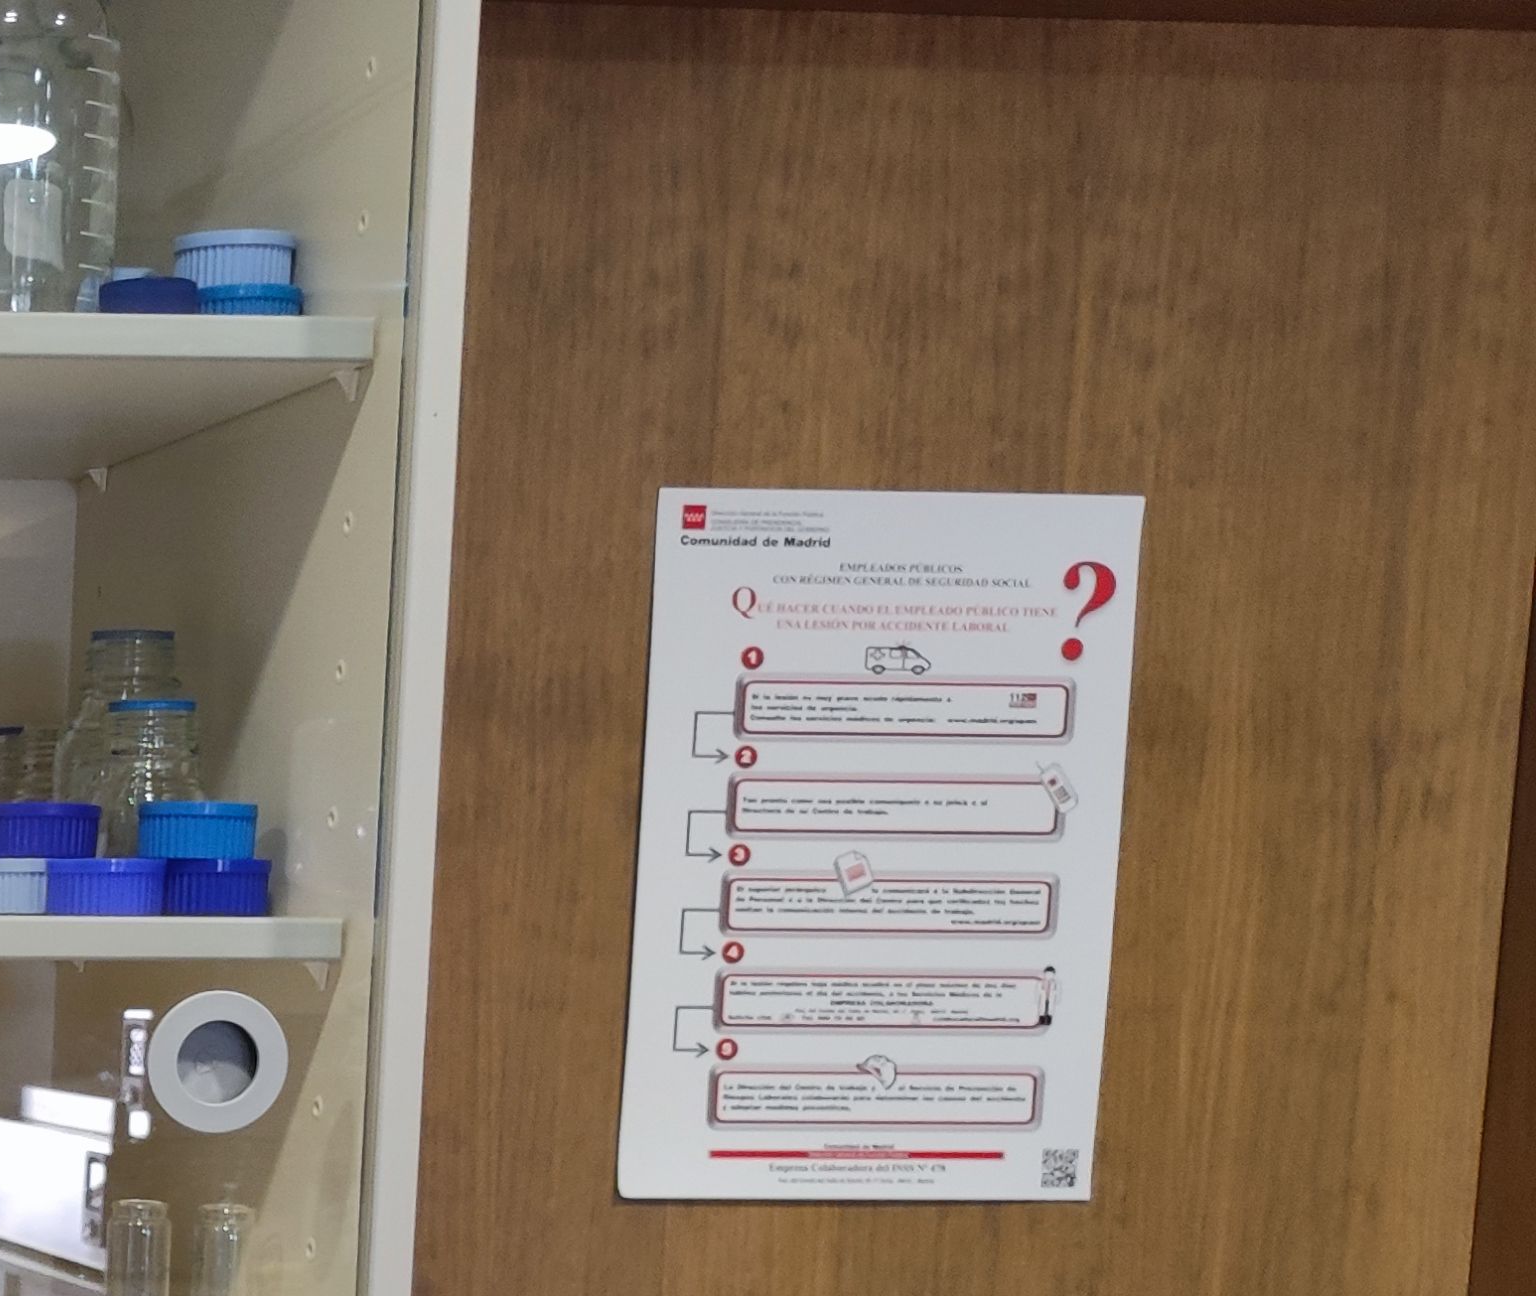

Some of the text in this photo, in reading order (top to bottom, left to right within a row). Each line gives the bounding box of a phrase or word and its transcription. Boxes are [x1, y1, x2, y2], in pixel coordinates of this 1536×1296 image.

[680, 535, 831, 549] Comunidad de Madrid
[839, 562, 906, 572] EMPLEADOS
[773, 575, 797, 585] CON
[853, 576, 904, 586] GENERAL
[908, 577, 922, 586] DE
[925, 577, 988, 587] SEGURIDAD
[992, 578, 1030, 588] SOCIAL
[777, 602, 819, 614] HACER
[822, 603, 873, 614] CUANDO
[895, 604, 962, 616] EMPLEADO
[1023, 606, 1057, 617] TIENE
[880, 621, 948, 632] ACCIDENTE
[952, 622, 1008, 633] LABORAL
